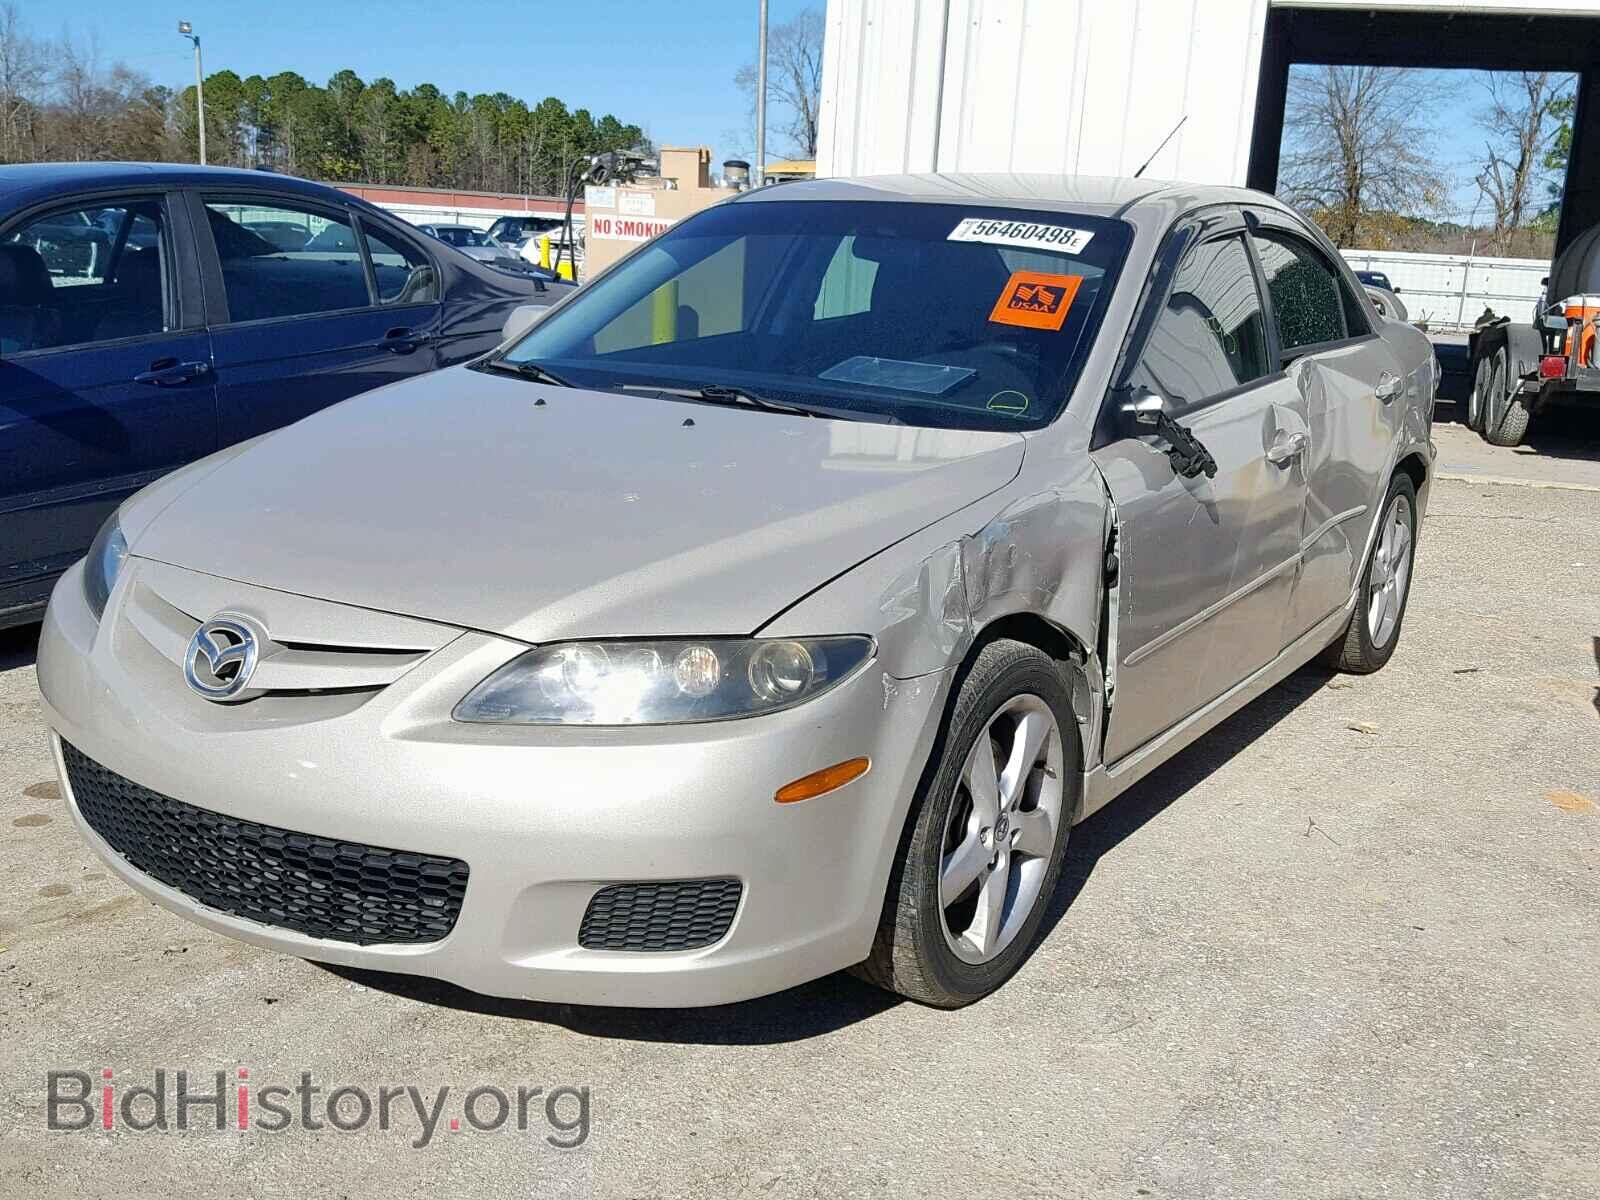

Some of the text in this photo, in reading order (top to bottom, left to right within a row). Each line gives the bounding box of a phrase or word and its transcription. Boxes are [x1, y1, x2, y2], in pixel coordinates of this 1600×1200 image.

[594, 218, 667, 238] NO SMOKIN
[973, 221, 1075, 244] 56460498
[1010, 301, 1049, 313] USAA
